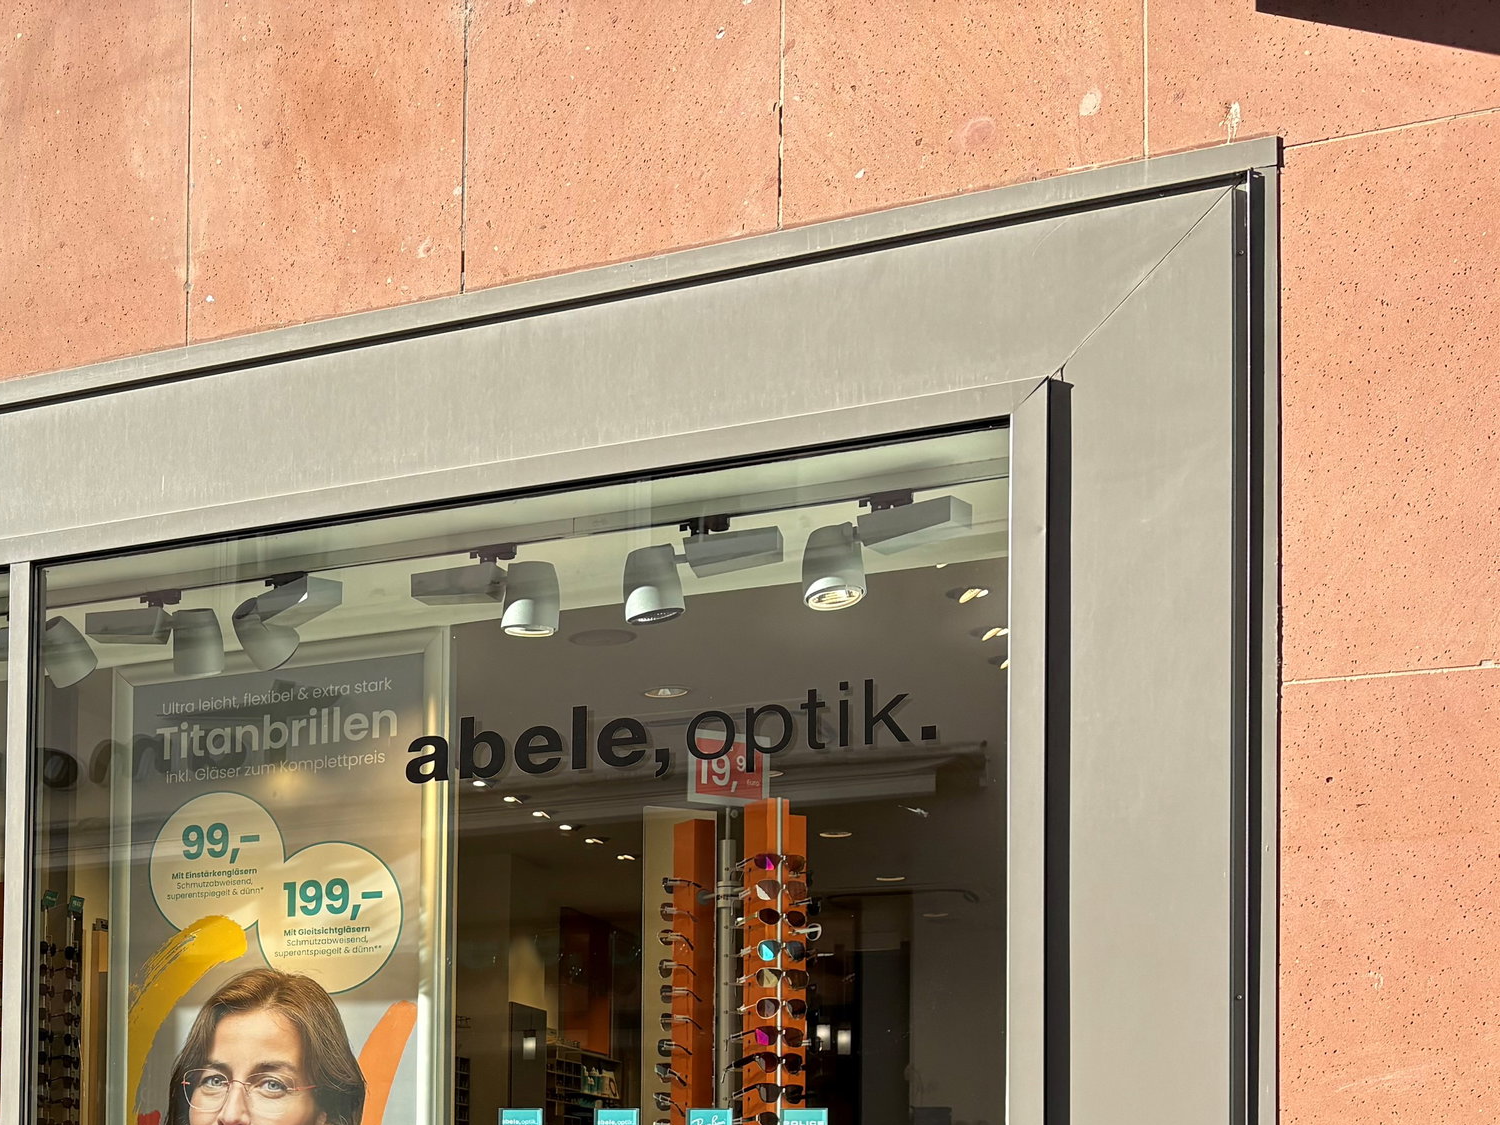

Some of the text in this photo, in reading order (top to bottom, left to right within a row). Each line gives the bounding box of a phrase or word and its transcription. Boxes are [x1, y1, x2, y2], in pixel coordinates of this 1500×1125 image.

[162, 677, 393, 716] Ultra leicht, flexibel & extra stark
[156, 706, 398, 761] Titanbrillen
[405, 678, 938, 785] abele,optik.
[165, 750, 386, 785] inkl. Gläser zum Komplettpreis
[181, 822, 261, 864] 99,-
[185, 868, 258, 879] Einstärkengläsern
[283, 878, 383, 921] 199,-
[298, 925, 370, 936] Gleitsichtgläsern
